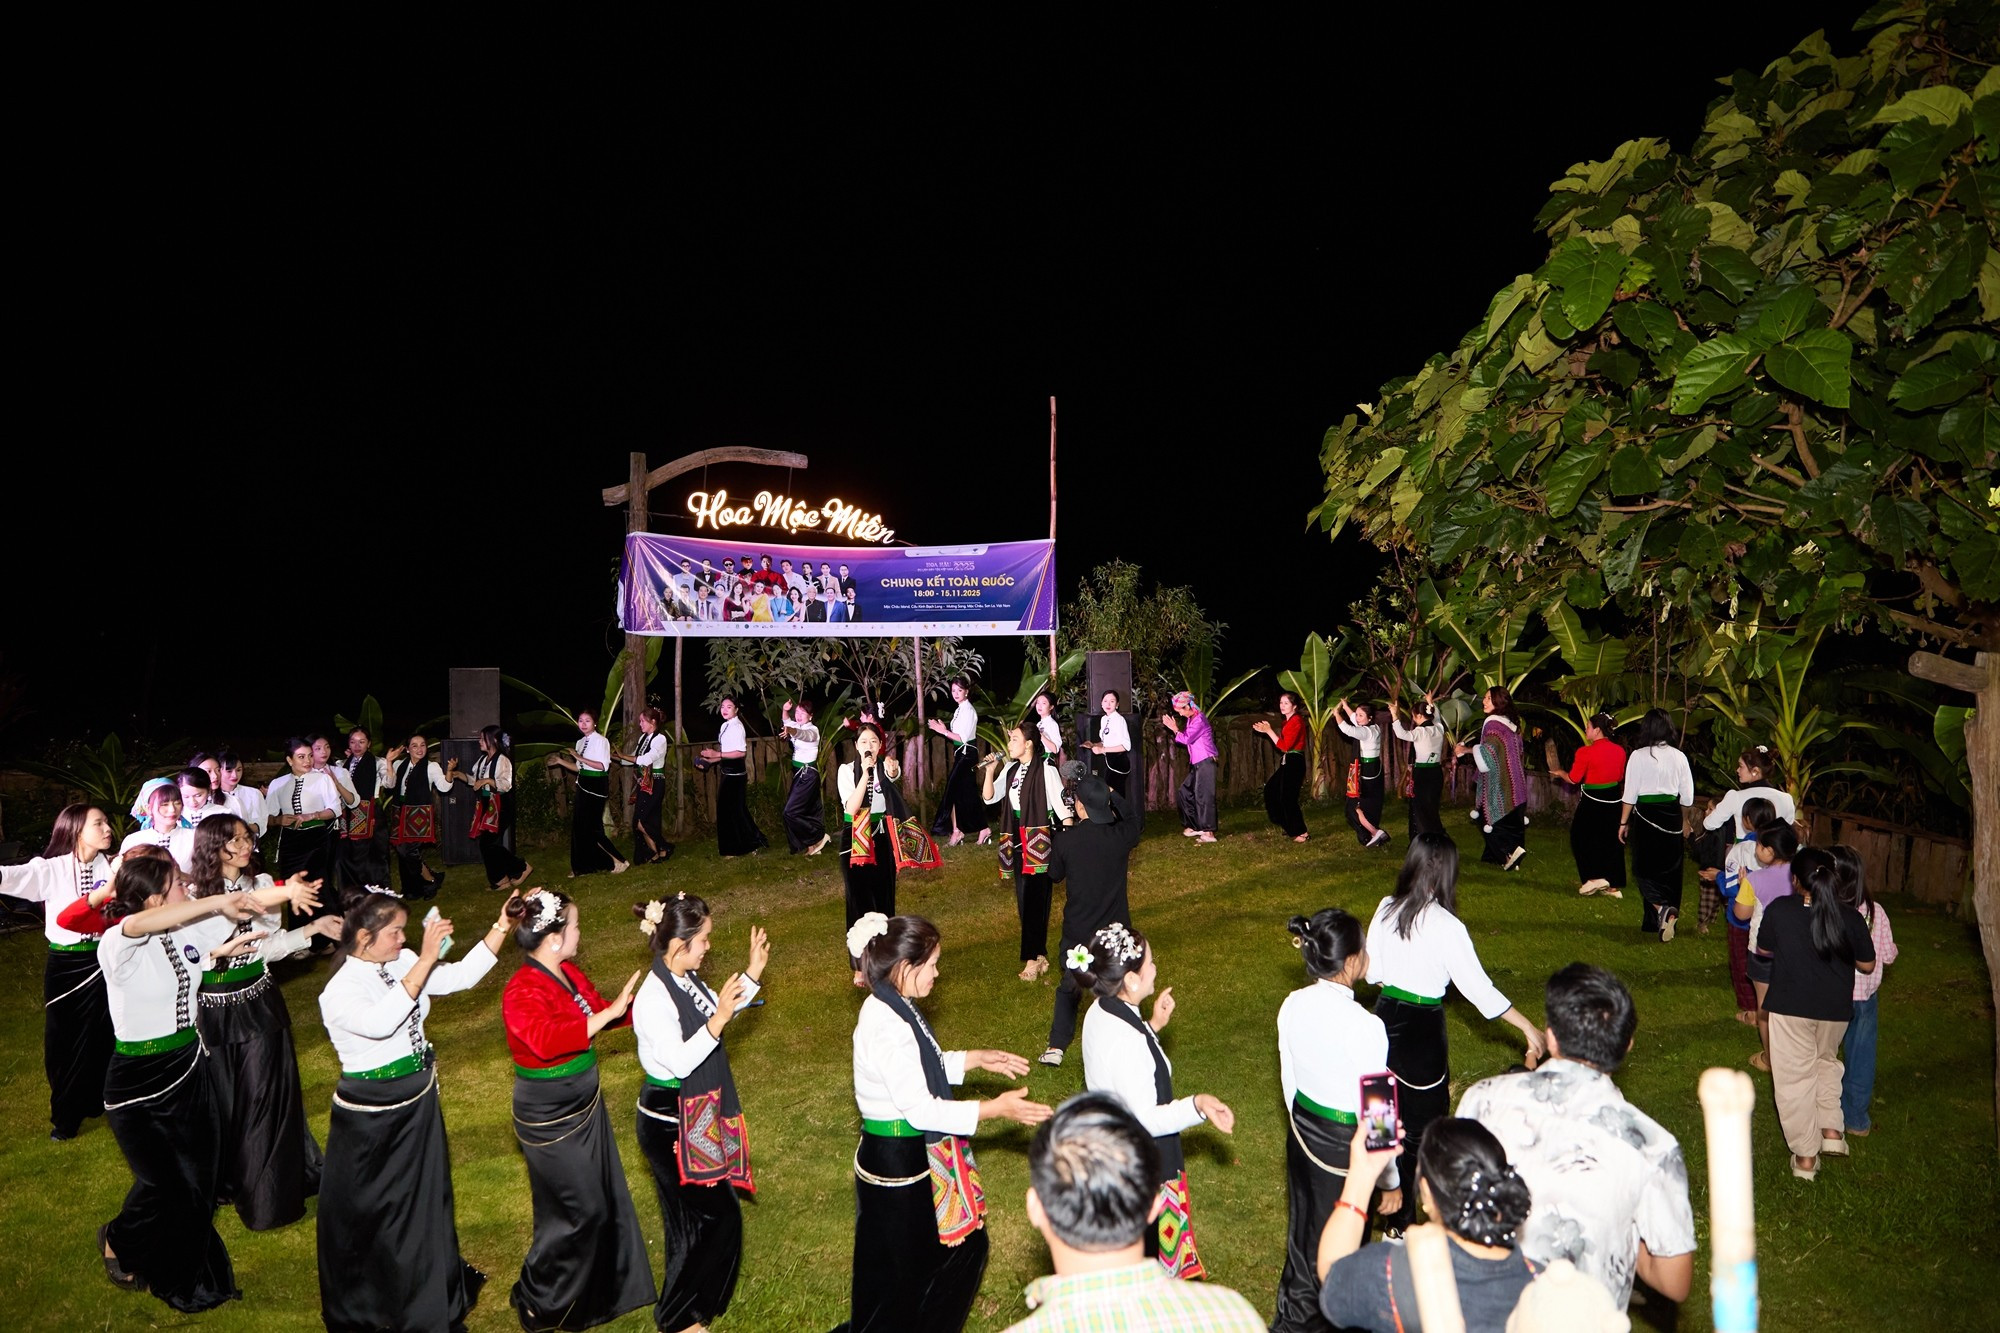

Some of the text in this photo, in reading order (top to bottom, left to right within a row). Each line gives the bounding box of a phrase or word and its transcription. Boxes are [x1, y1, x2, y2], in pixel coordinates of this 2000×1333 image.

[687, 489, 895, 544] Hoa Mộc Miên
[881, 574, 1015, 588] CHUNG KẾT TOÀN QUỐC
